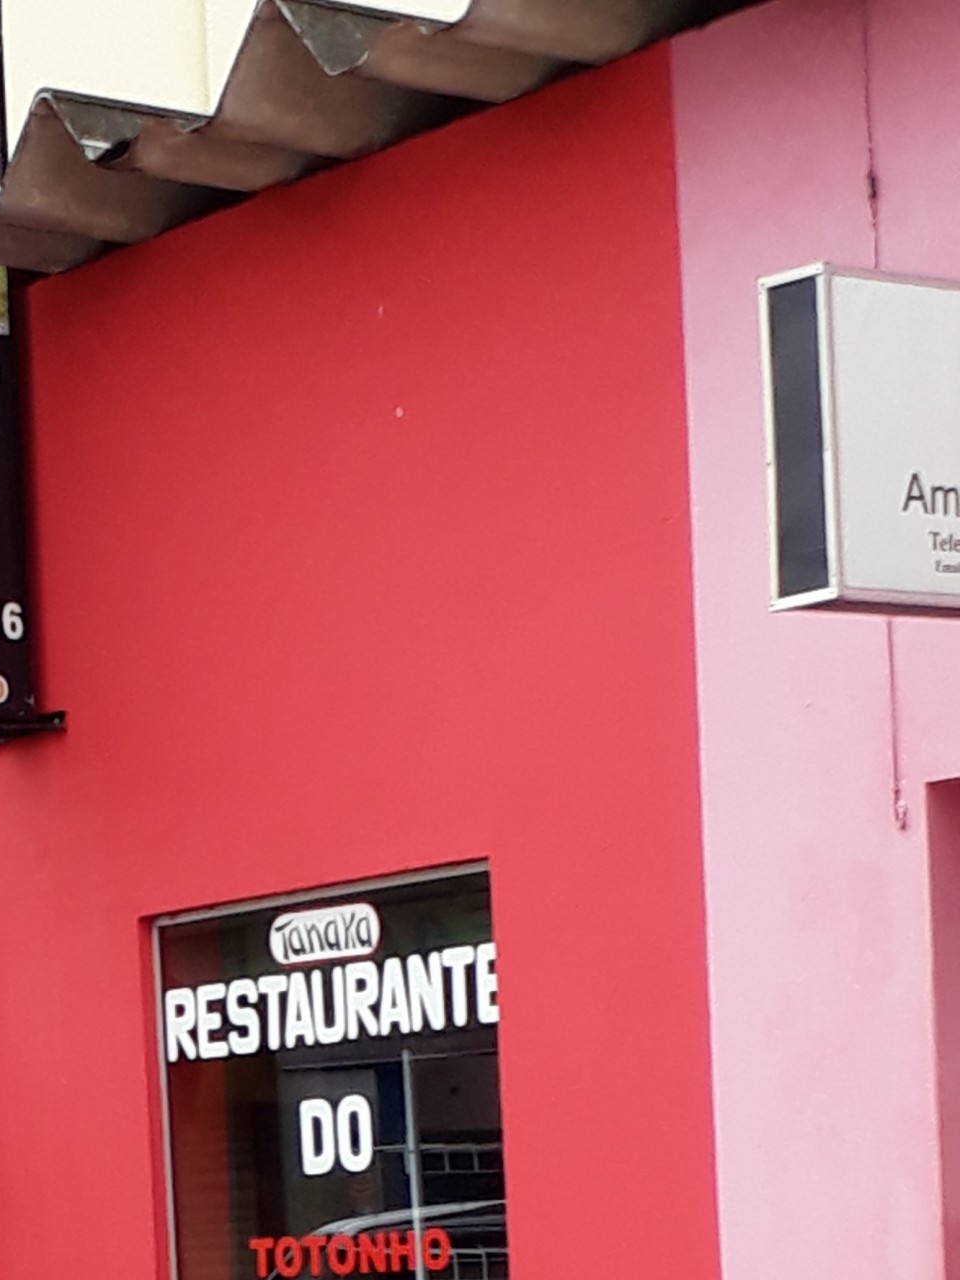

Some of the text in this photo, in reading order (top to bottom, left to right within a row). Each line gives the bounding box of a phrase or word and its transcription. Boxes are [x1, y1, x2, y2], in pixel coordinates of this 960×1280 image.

[165, 942, 499, 1063] RESTAURANTE
[300, 1094, 373, 1175] DO
[250, 1227, 452, 1279] TOTONHO
